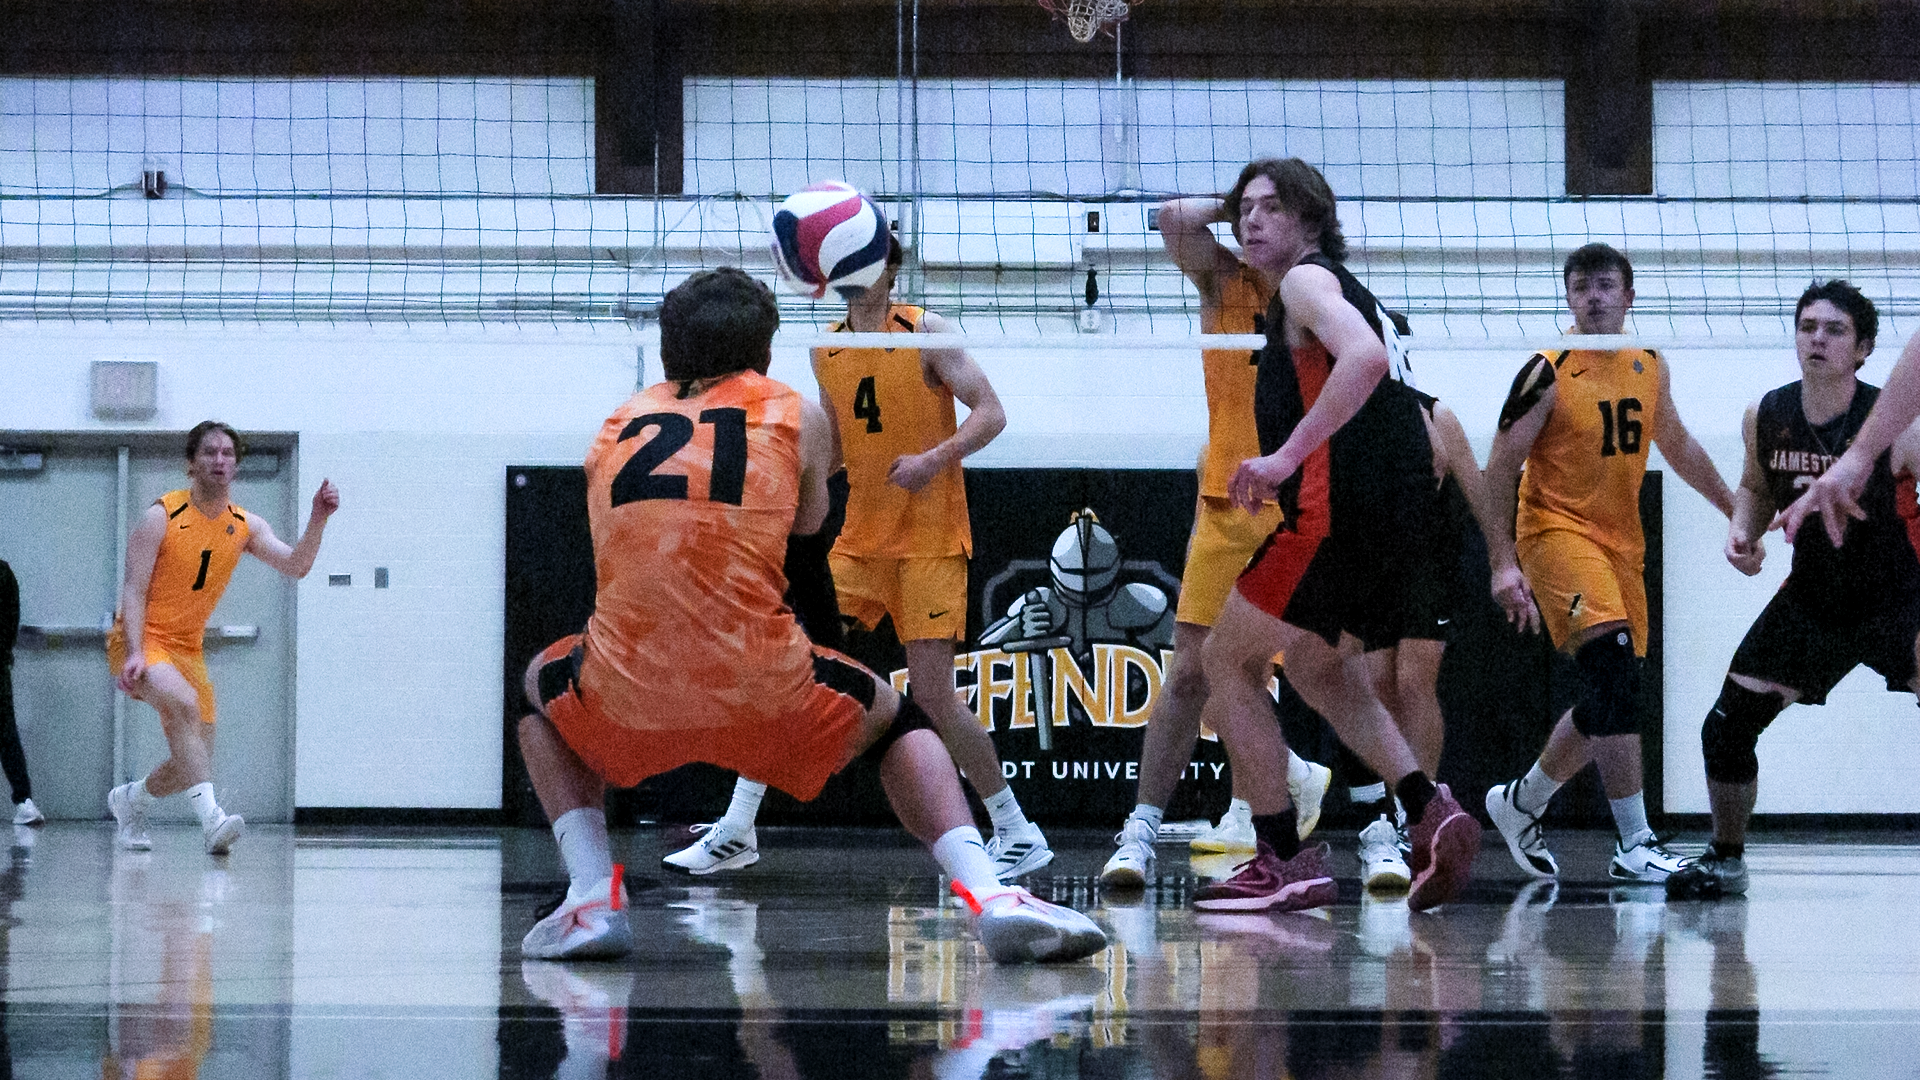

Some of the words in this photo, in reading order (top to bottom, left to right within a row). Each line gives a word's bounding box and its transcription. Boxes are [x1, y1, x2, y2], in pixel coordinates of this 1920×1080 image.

[853, 375, 883, 434] 4
[1597, 397, 1643, 457] 16
[610, 407, 748, 508] 21
[1769, 449, 1841, 474] JAMEST
[191, 549, 213, 592] 1
[1052, 760, 1226, 781] UNIVETY
